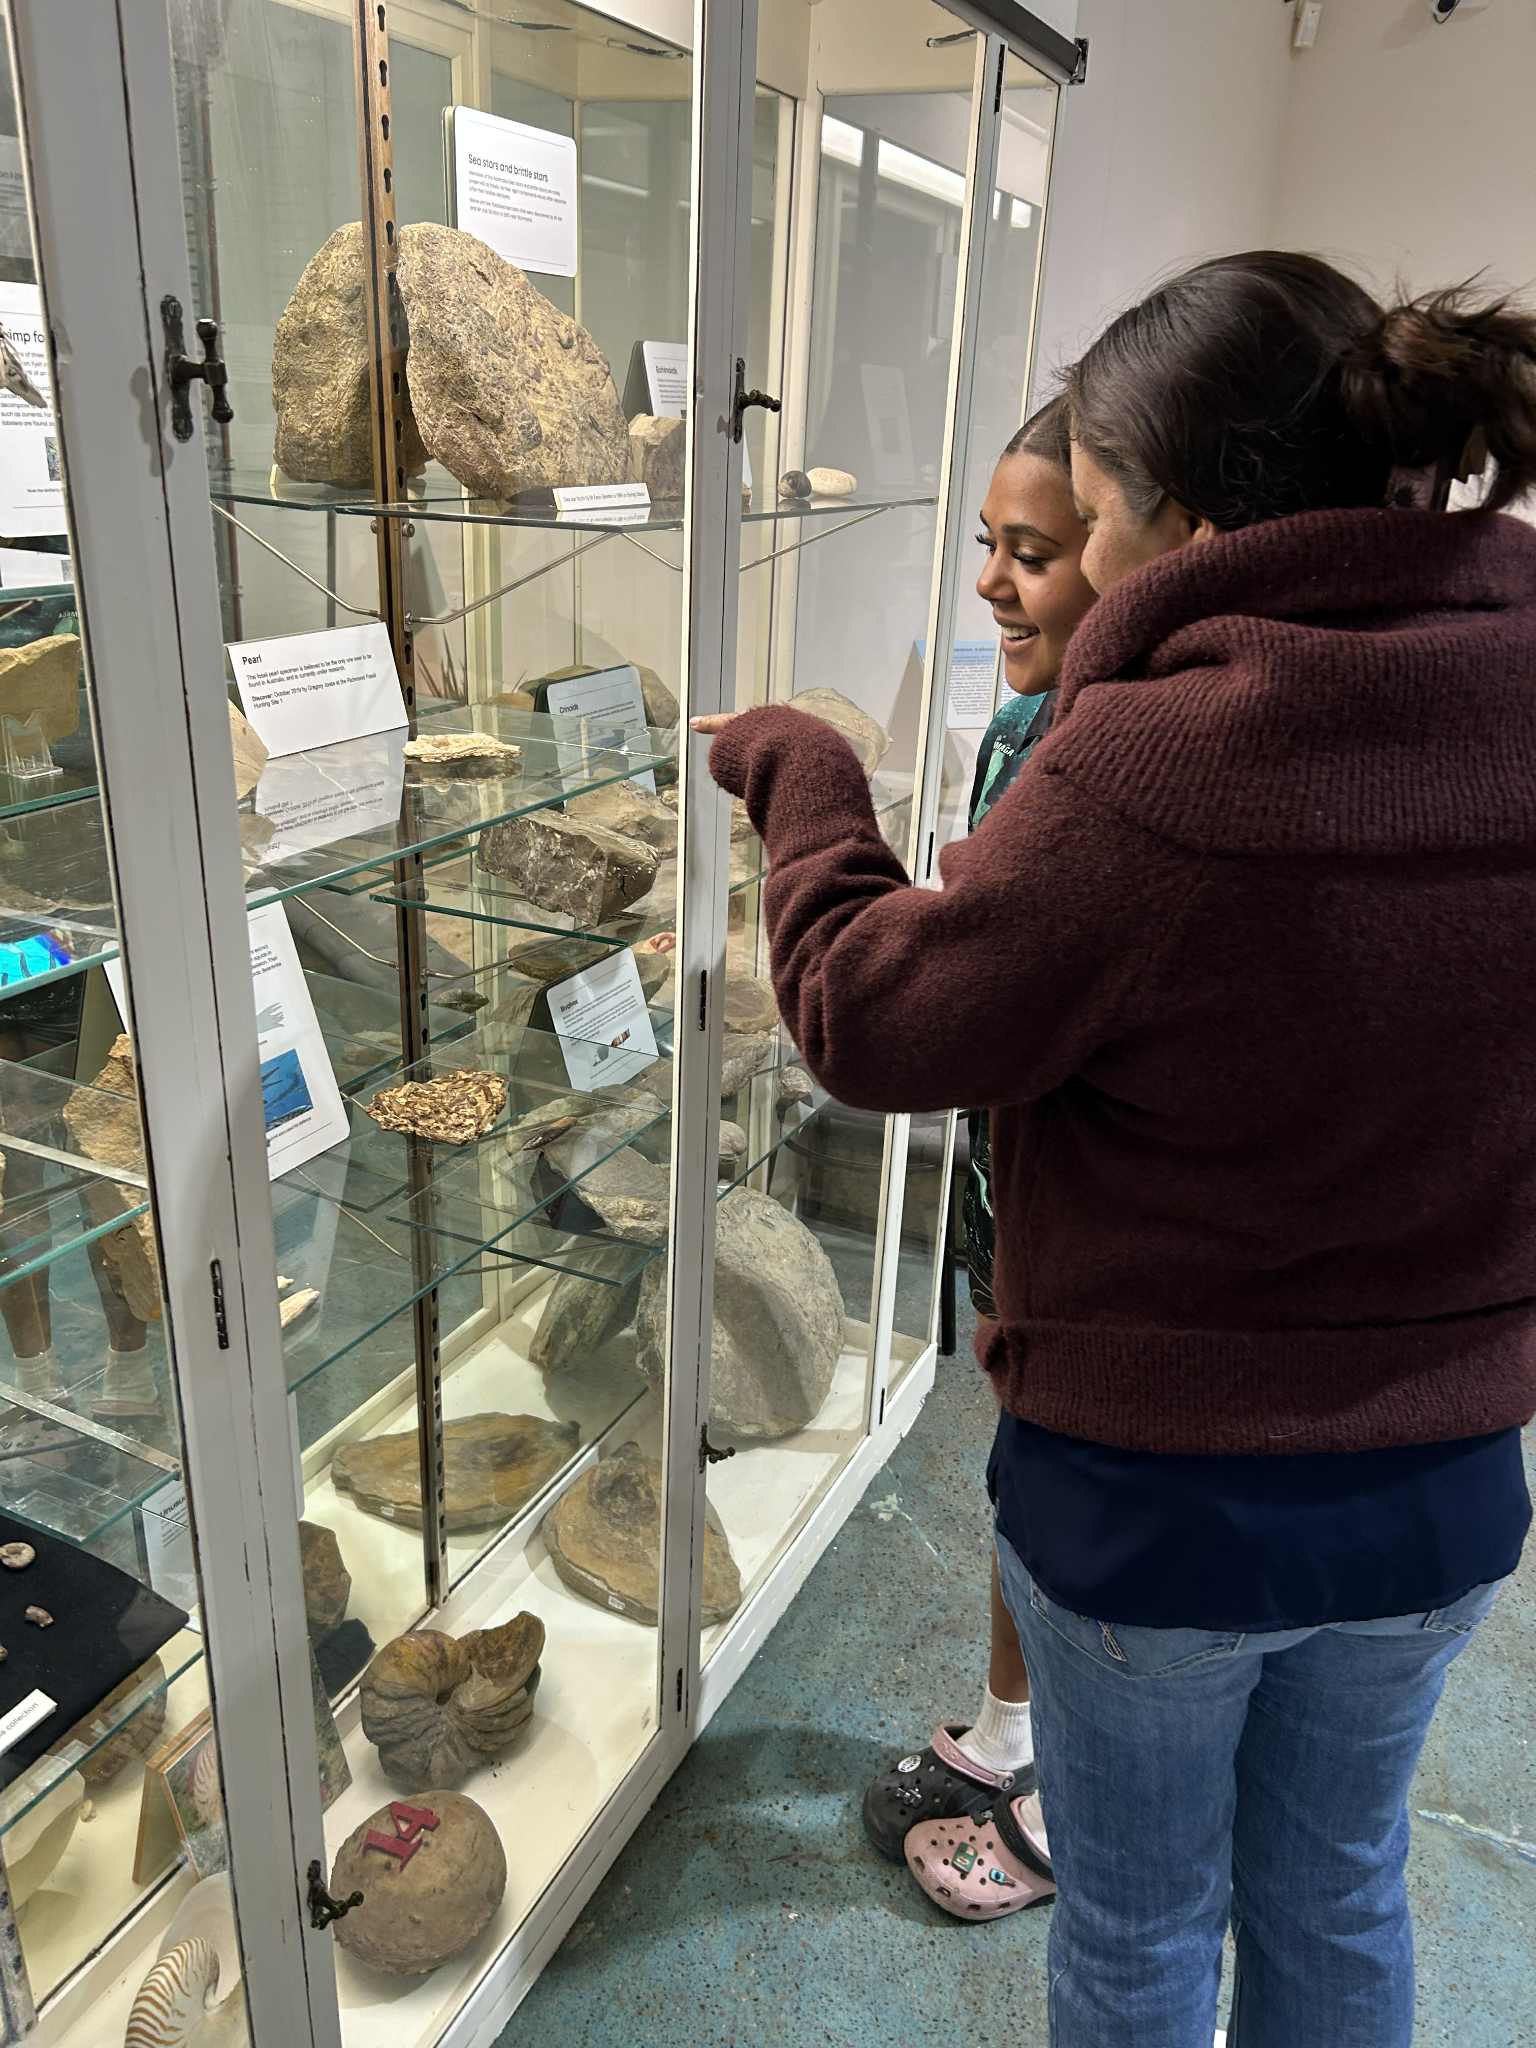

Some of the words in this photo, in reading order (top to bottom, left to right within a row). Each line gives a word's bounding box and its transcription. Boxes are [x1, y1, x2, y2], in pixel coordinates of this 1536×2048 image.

[468, 154, 482, 166] Sea
[482, 158, 498, 170] stars
[500, 162, 512, 174] and
[514, 164, 532, 179] brittle
[534, 170, 548, 182] stars
[8, 329, 30, 344] imp
[33, 330, 45, 342] fo
[242, 654, 262, 666] Pearl
[269, 670, 279, 678] pearl
[280, 667, 299, 676] specimen
